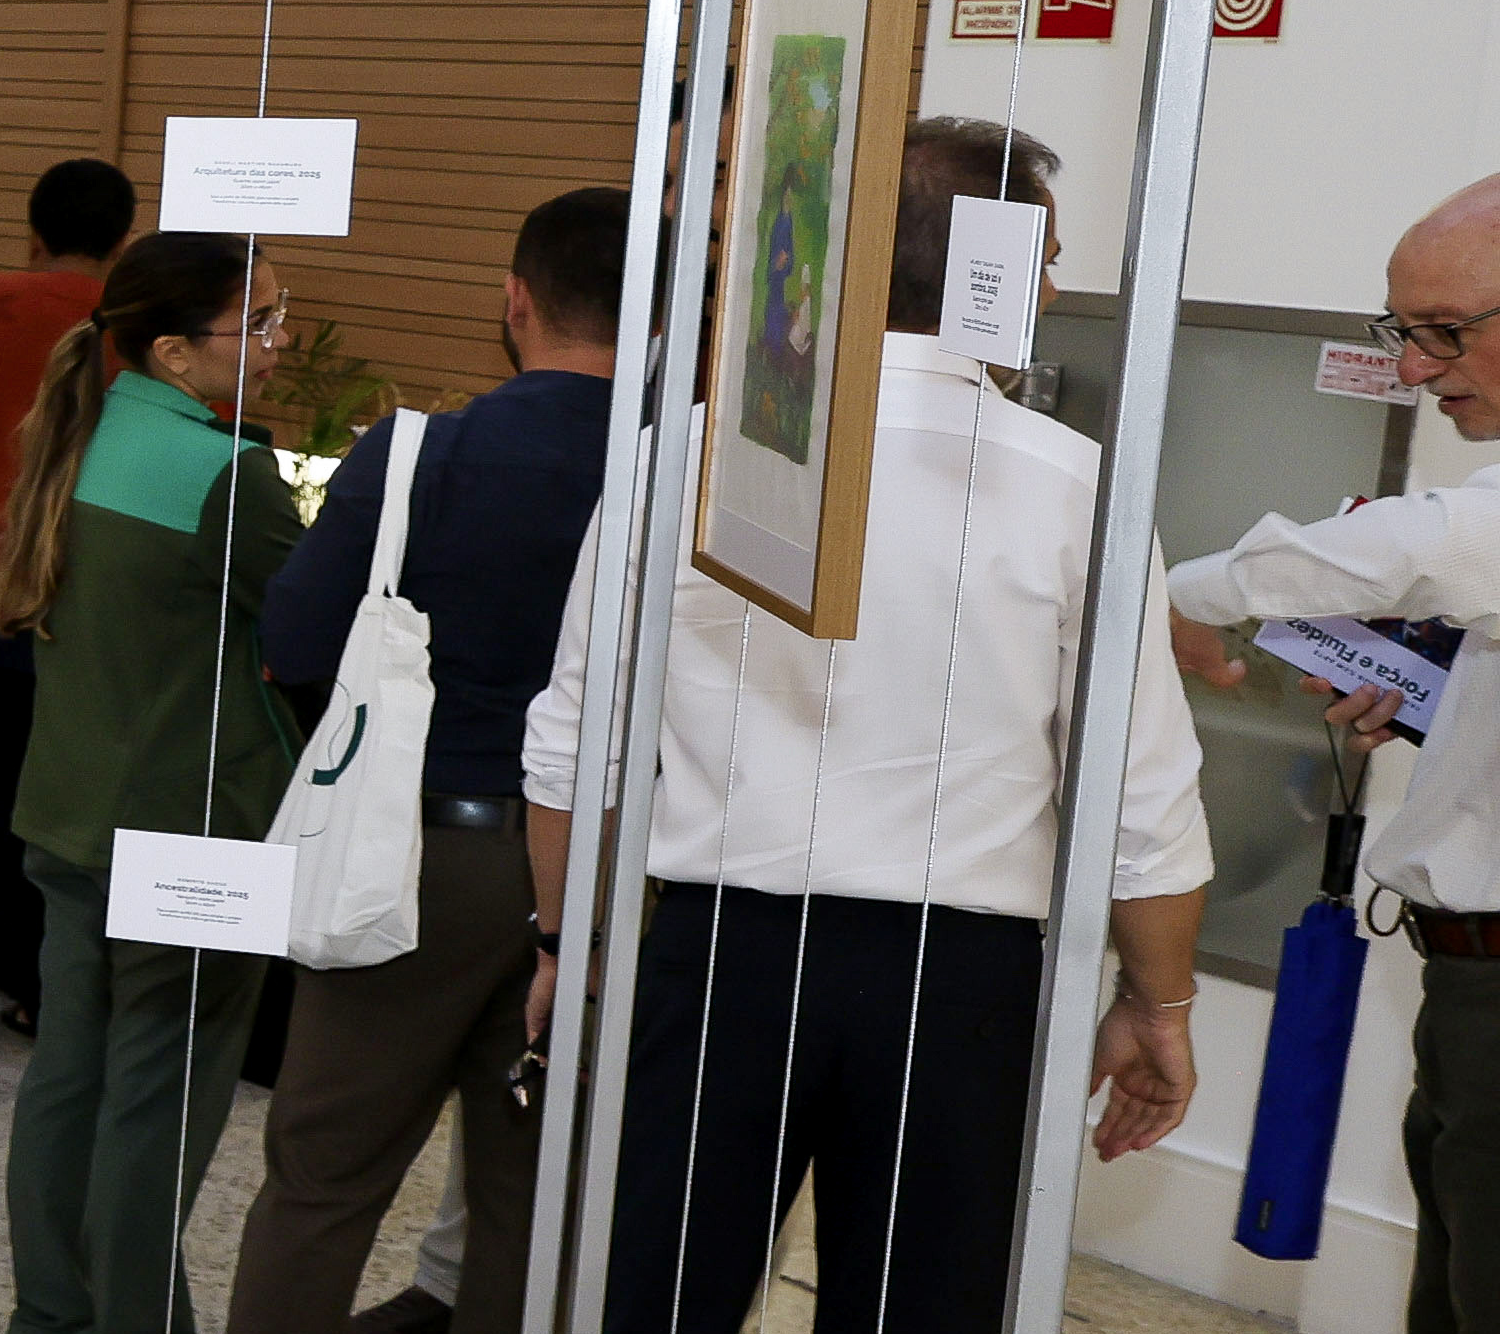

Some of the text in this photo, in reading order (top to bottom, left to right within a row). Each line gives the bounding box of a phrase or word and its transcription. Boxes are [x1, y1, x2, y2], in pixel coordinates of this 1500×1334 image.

[298, 170, 322, 179] 2025
[1287, 617, 1359, 663] Fluidez
[1359, 656, 1375, 668] e
[1377, 665, 1431, 703] Força
[227, 889, 249, 900] 2025
